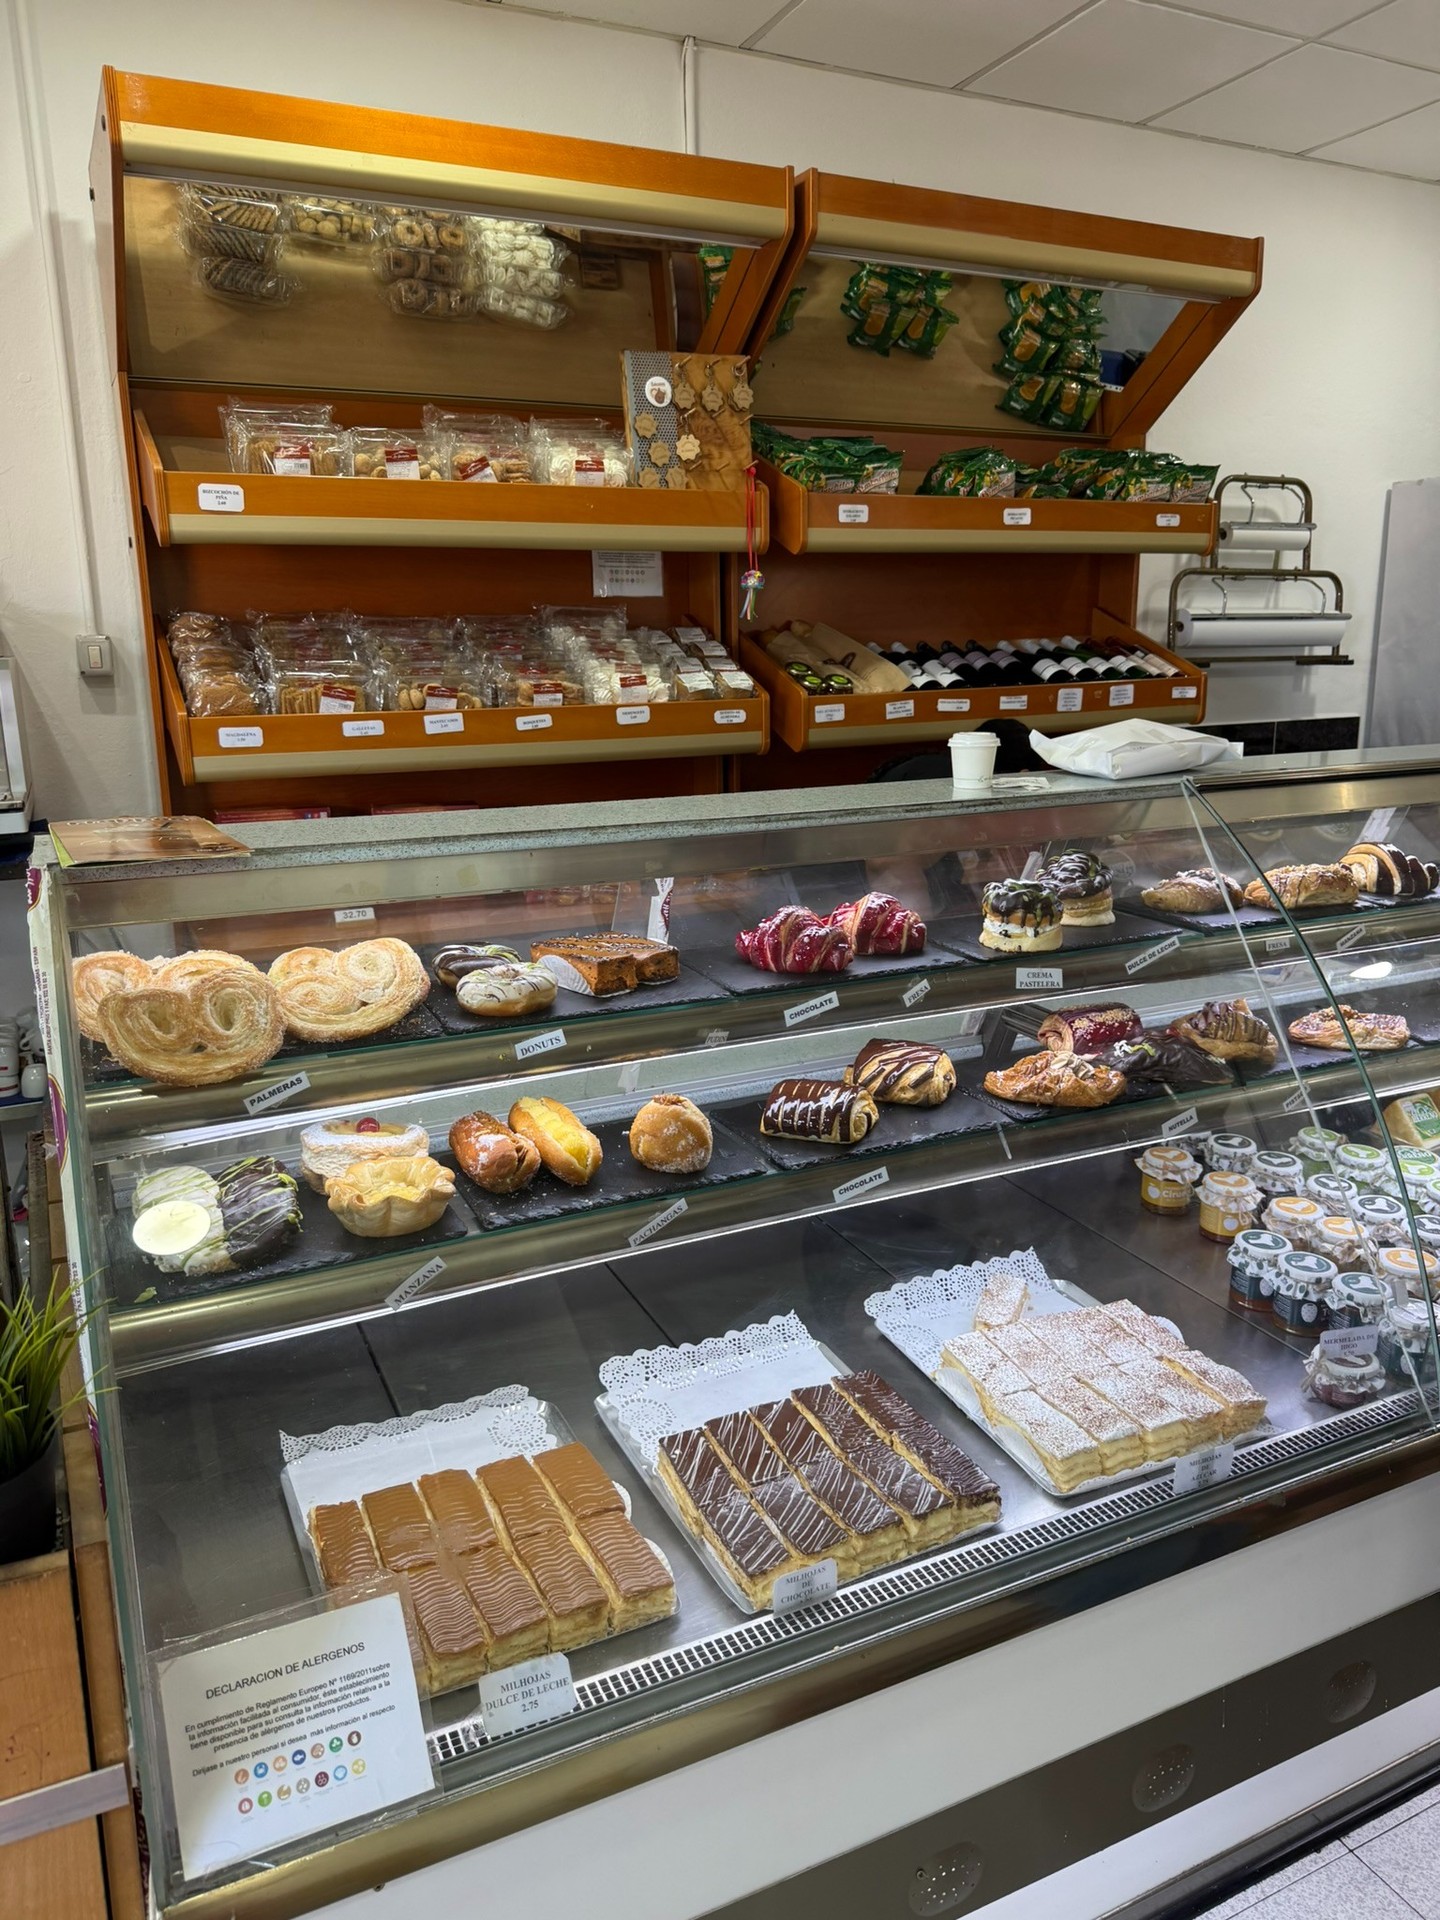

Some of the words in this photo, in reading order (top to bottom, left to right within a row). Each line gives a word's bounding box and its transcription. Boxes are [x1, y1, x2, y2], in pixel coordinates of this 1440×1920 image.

[342, 910, 367, 919] 32.70
[1128, 956, 1148, 971] DULCE
[1148, 952, 1157, 960] DE
[1157, 940, 1177, 955] LECHE
[1267, 941, 1287, 950] FRESA
[1027, 971, 1053, 979] CREMA
[908, 985, 929, 1003] FRESA
[789, 997, 834, 1020] CHOCOLATE
[520, 1035, 561, 1056] DONUTS
[249, 1077, 303, 1106] PALMERAS
[1168, 1115, 1194, 1132] NUTELLA
[838, 1172, 883, 1195] CHOCOLATE
[632, 1205, 683, 1244] PACHANGAS
[394, 1264, 443, 1305] MANZANA
[1323, 1335, 1365, 1345] MERMELADA
[1189, 1453, 1222, 1466] MILHOJAS
[785, 1566, 826, 1585] MILHOJAS
[802, 1580, 813, 1589] DE
[780, 1582, 831, 1604] CHOCOLATE
[205, 1667, 284, 1699] DECLARACION
[285, 1662, 301, 1675] DE
[301, 1642, 366, 1669] ALERGENOS
[500, 1670, 551, 1694] MILHOJAS
[485, 1692, 520, 1711] DULCE
[521, 1687, 535, 1700] DE
[537, 1676, 570, 1695] LECHE
[185, 1723, 196, 1733] En
[196, 1708, 244, 1731] cumplimiento
[244, 1705, 255, 1715] de
[255, 1692, 298, 1712] Reglamento
[299, 1682, 328, 1698] Europeo
[188, 1733, 196, 1741] la
[197, 1720, 239, 1738] información
[239, 1708, 271, 1725] facilitada
[272, 1706, 279, 1715] al
[280, 1694, 322, 1713] consumidor,
[338, 1671, 390, 1693] establecimiento
[190, 1739, 208, 1750] tiene
[209, 1726, 246, 1745] disponible
[247, 1722, 264, 1736] para
[264, 1718, 274, 1727] su
[274, 1708, 304, 1724] consulta
[304, 1705, 312, 1714] la
[312, 1691, 352, 1711] información
[352, 1685, 377, 1699] relativa
[384, 1680, 391, 1688] la
[521, 1699, 539, 1713] 2.75
[213, 1734, 249, 1753] presencia
[249, 1730, 260, 1740] de
[260, 1719, 295, 1738] alérgenos
[296, 1715, 306, 1725] de
[306, 1706, 336, 1723] nuestros
[337, 1695, 371, 1714] productos.
[225, 1752, 250, 1767] nuestro
[251, 1742, 280, 1759] personal
[287, 1733, 308, 1746] desea
[310, 1726, 325, 1738] más
[324, 1715, 361, 1734] información
[369, 1704, 396, 1719] respecto
